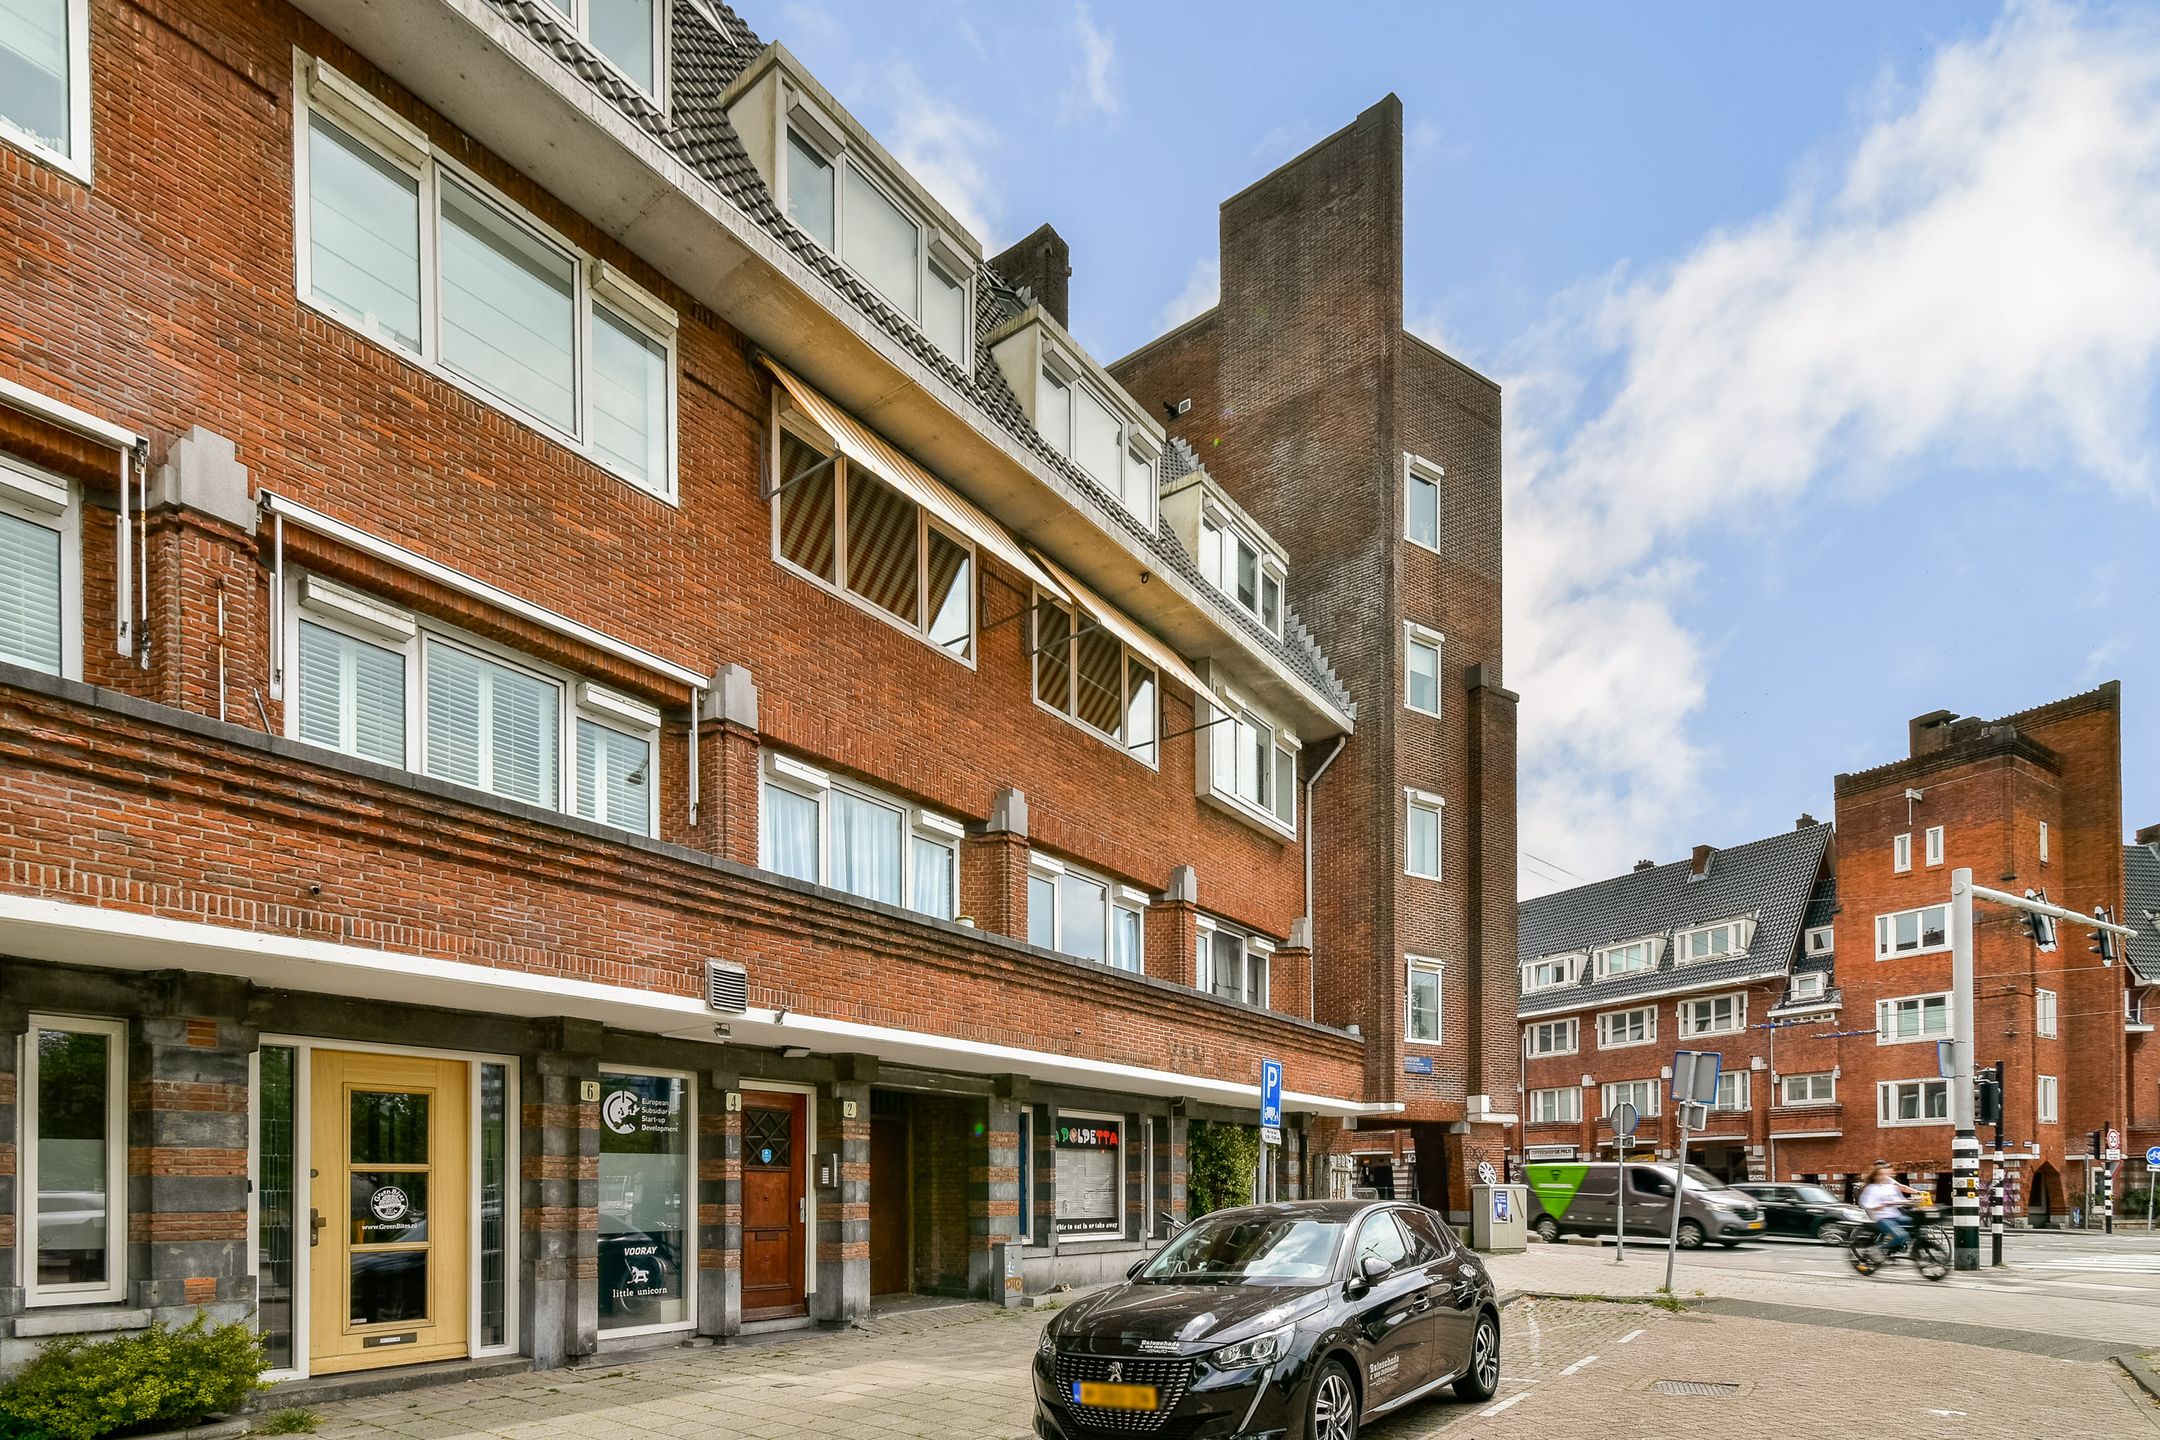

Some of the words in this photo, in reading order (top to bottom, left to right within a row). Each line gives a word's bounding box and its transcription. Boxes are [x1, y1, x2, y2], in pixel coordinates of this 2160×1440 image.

[1267, 1066, 1278, 1099] P
[587, 1083, 593, 1099] 6
[641, 1098, 669, 1106] European
[641, 1107, 671, 1116] Subsidiary
[641, 1115, 666, 1123] Start-up
[641, 1124, 679, 1132] Development
[1061, 1127, 1119, 1146] POLPETTA
[362, 1222, 418, 1230] www.GreenBites.nl
[624, 1246, 658, 1256] VOORAY
[612, 1288, 634, 1298] little
[637, 1287, 668, 1296] unicorn
